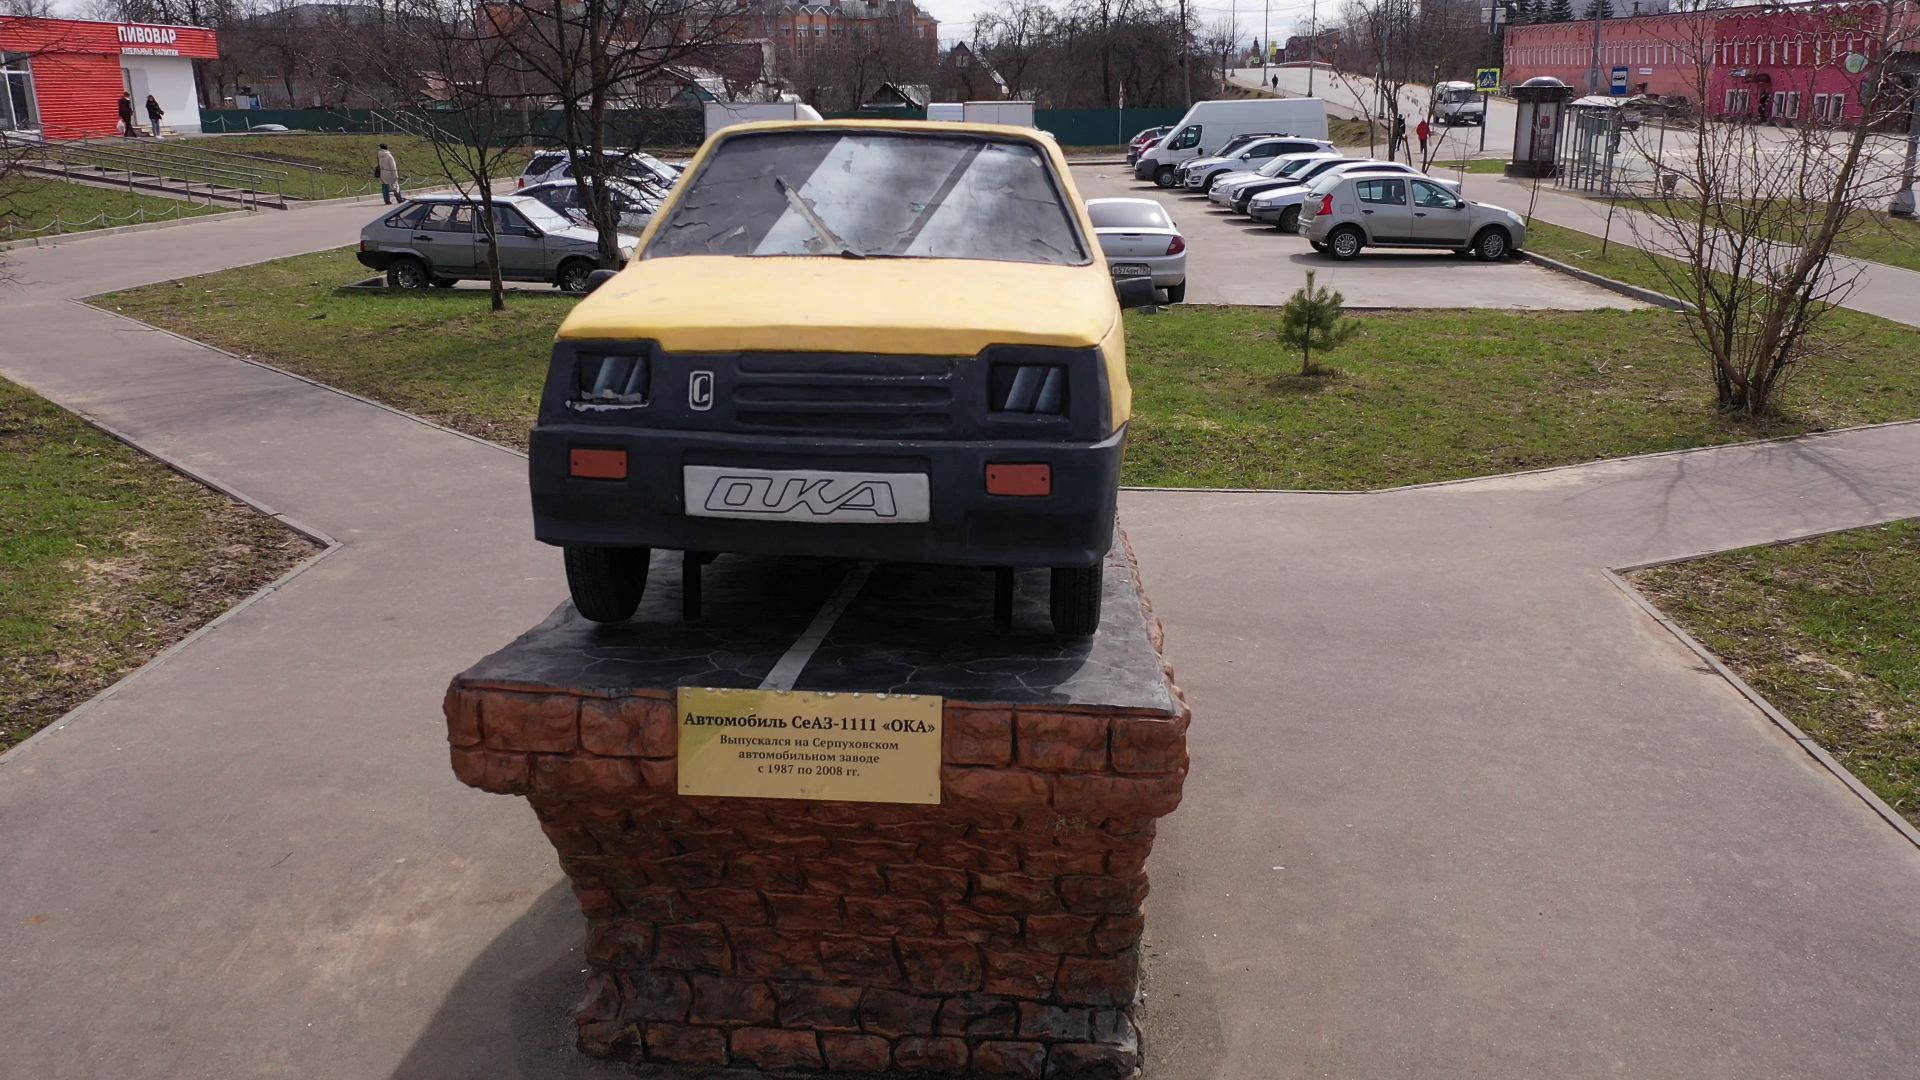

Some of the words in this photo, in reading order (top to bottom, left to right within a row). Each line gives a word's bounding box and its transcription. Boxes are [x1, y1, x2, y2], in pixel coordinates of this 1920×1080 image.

[117, 26, 177, 44] ПИВОВАР
[154, 48, 180, 57] НАПИТКИ
[684, 712, 788, 729] Автомобиль
[791, 715, 877, 731] СеАЗ-1111
[882, 718, 936, 733] «ОКА»
[720, 734, 792, 747] Выпускался
[794, 739, 809, 747] на
[812, 737, 899, 751] Серпуховском
[738, 750, 836, 762] автомобильном
[839, 754, 880, 764] заводе
[757, 765, 764, 773] с
[768, 763, 794, 774] 1987
[797, 766, 813, 775] по
[815, 765, 843, 776] 2008
[846, 768, 860, 777] гг.
